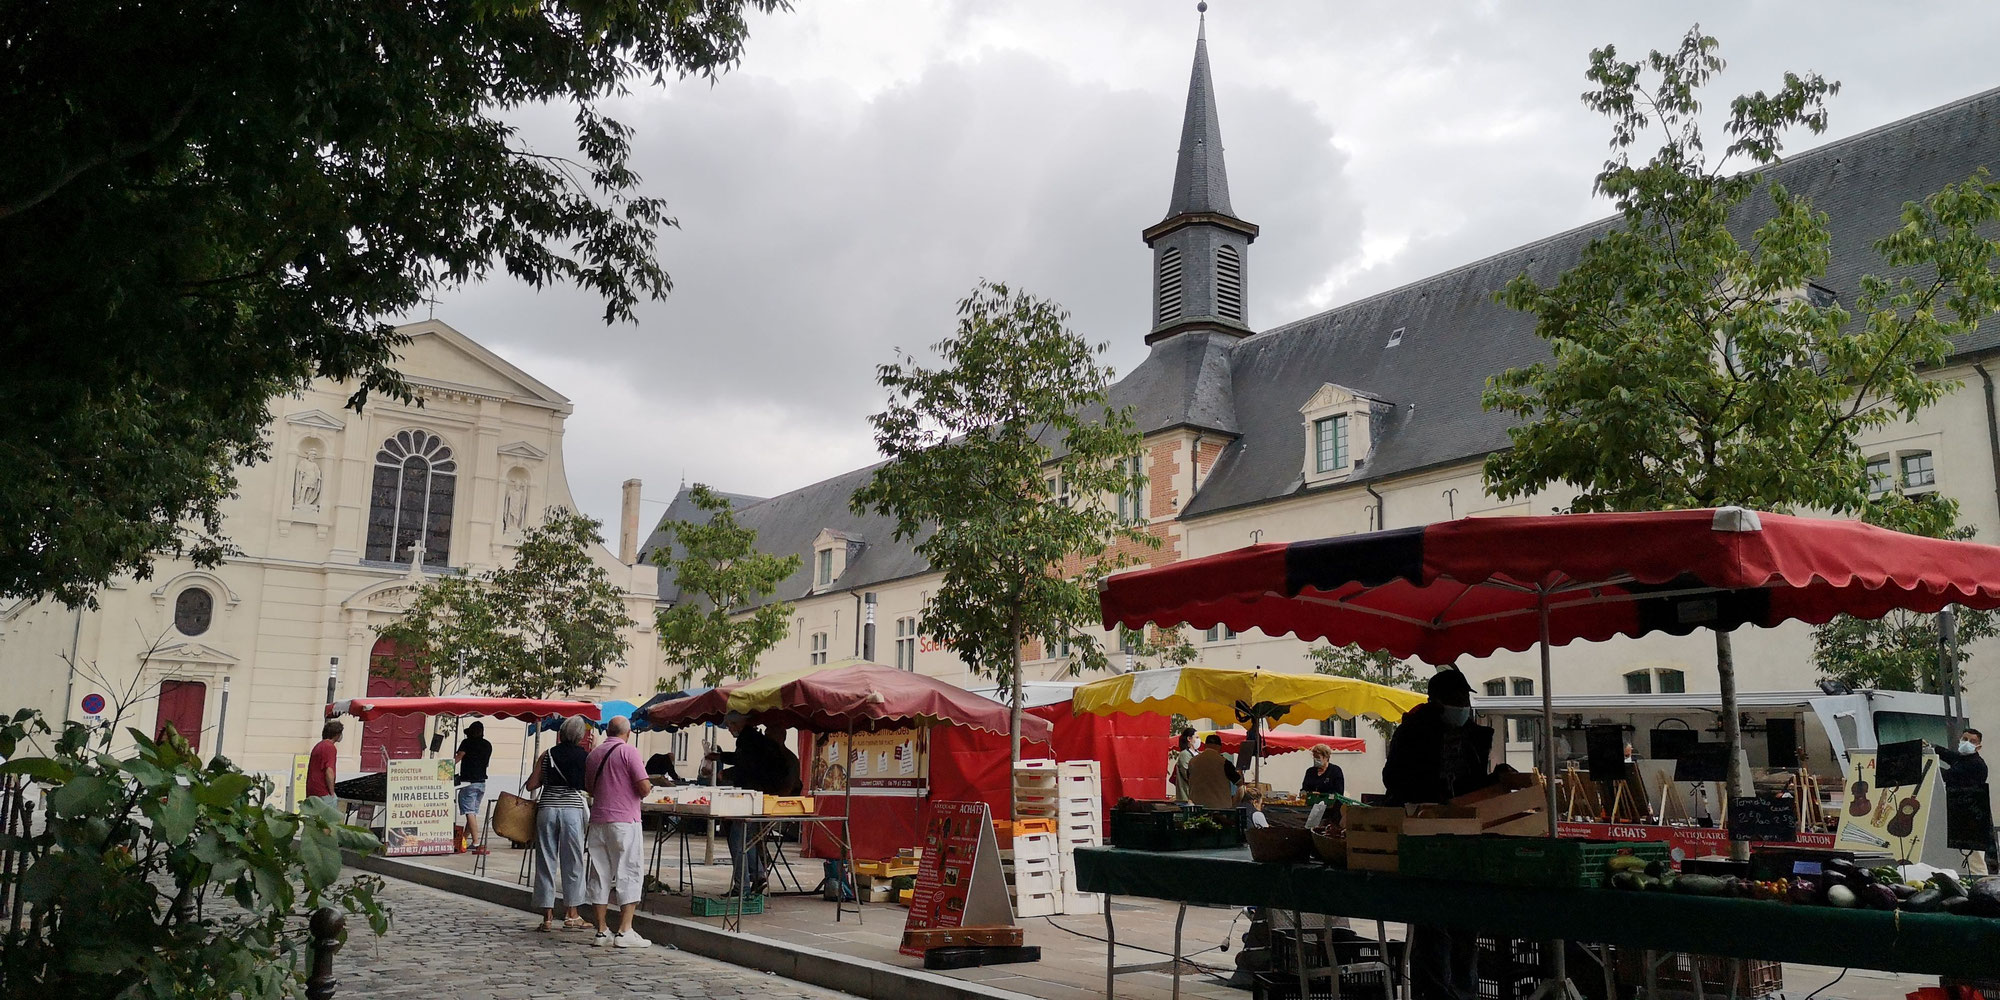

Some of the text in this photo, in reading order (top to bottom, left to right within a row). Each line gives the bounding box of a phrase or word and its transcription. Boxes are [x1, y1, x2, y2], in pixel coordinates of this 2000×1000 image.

[392, 791, 449, 801] MIRABELLES
[391, 809, 449, 819] à LONGEAUX
[959, 804, 983, 815] ACHATS
[1607, 826, 1647, 839] ACHATS
[1673, 831, 1727, 840] ANTIQUAIRE
